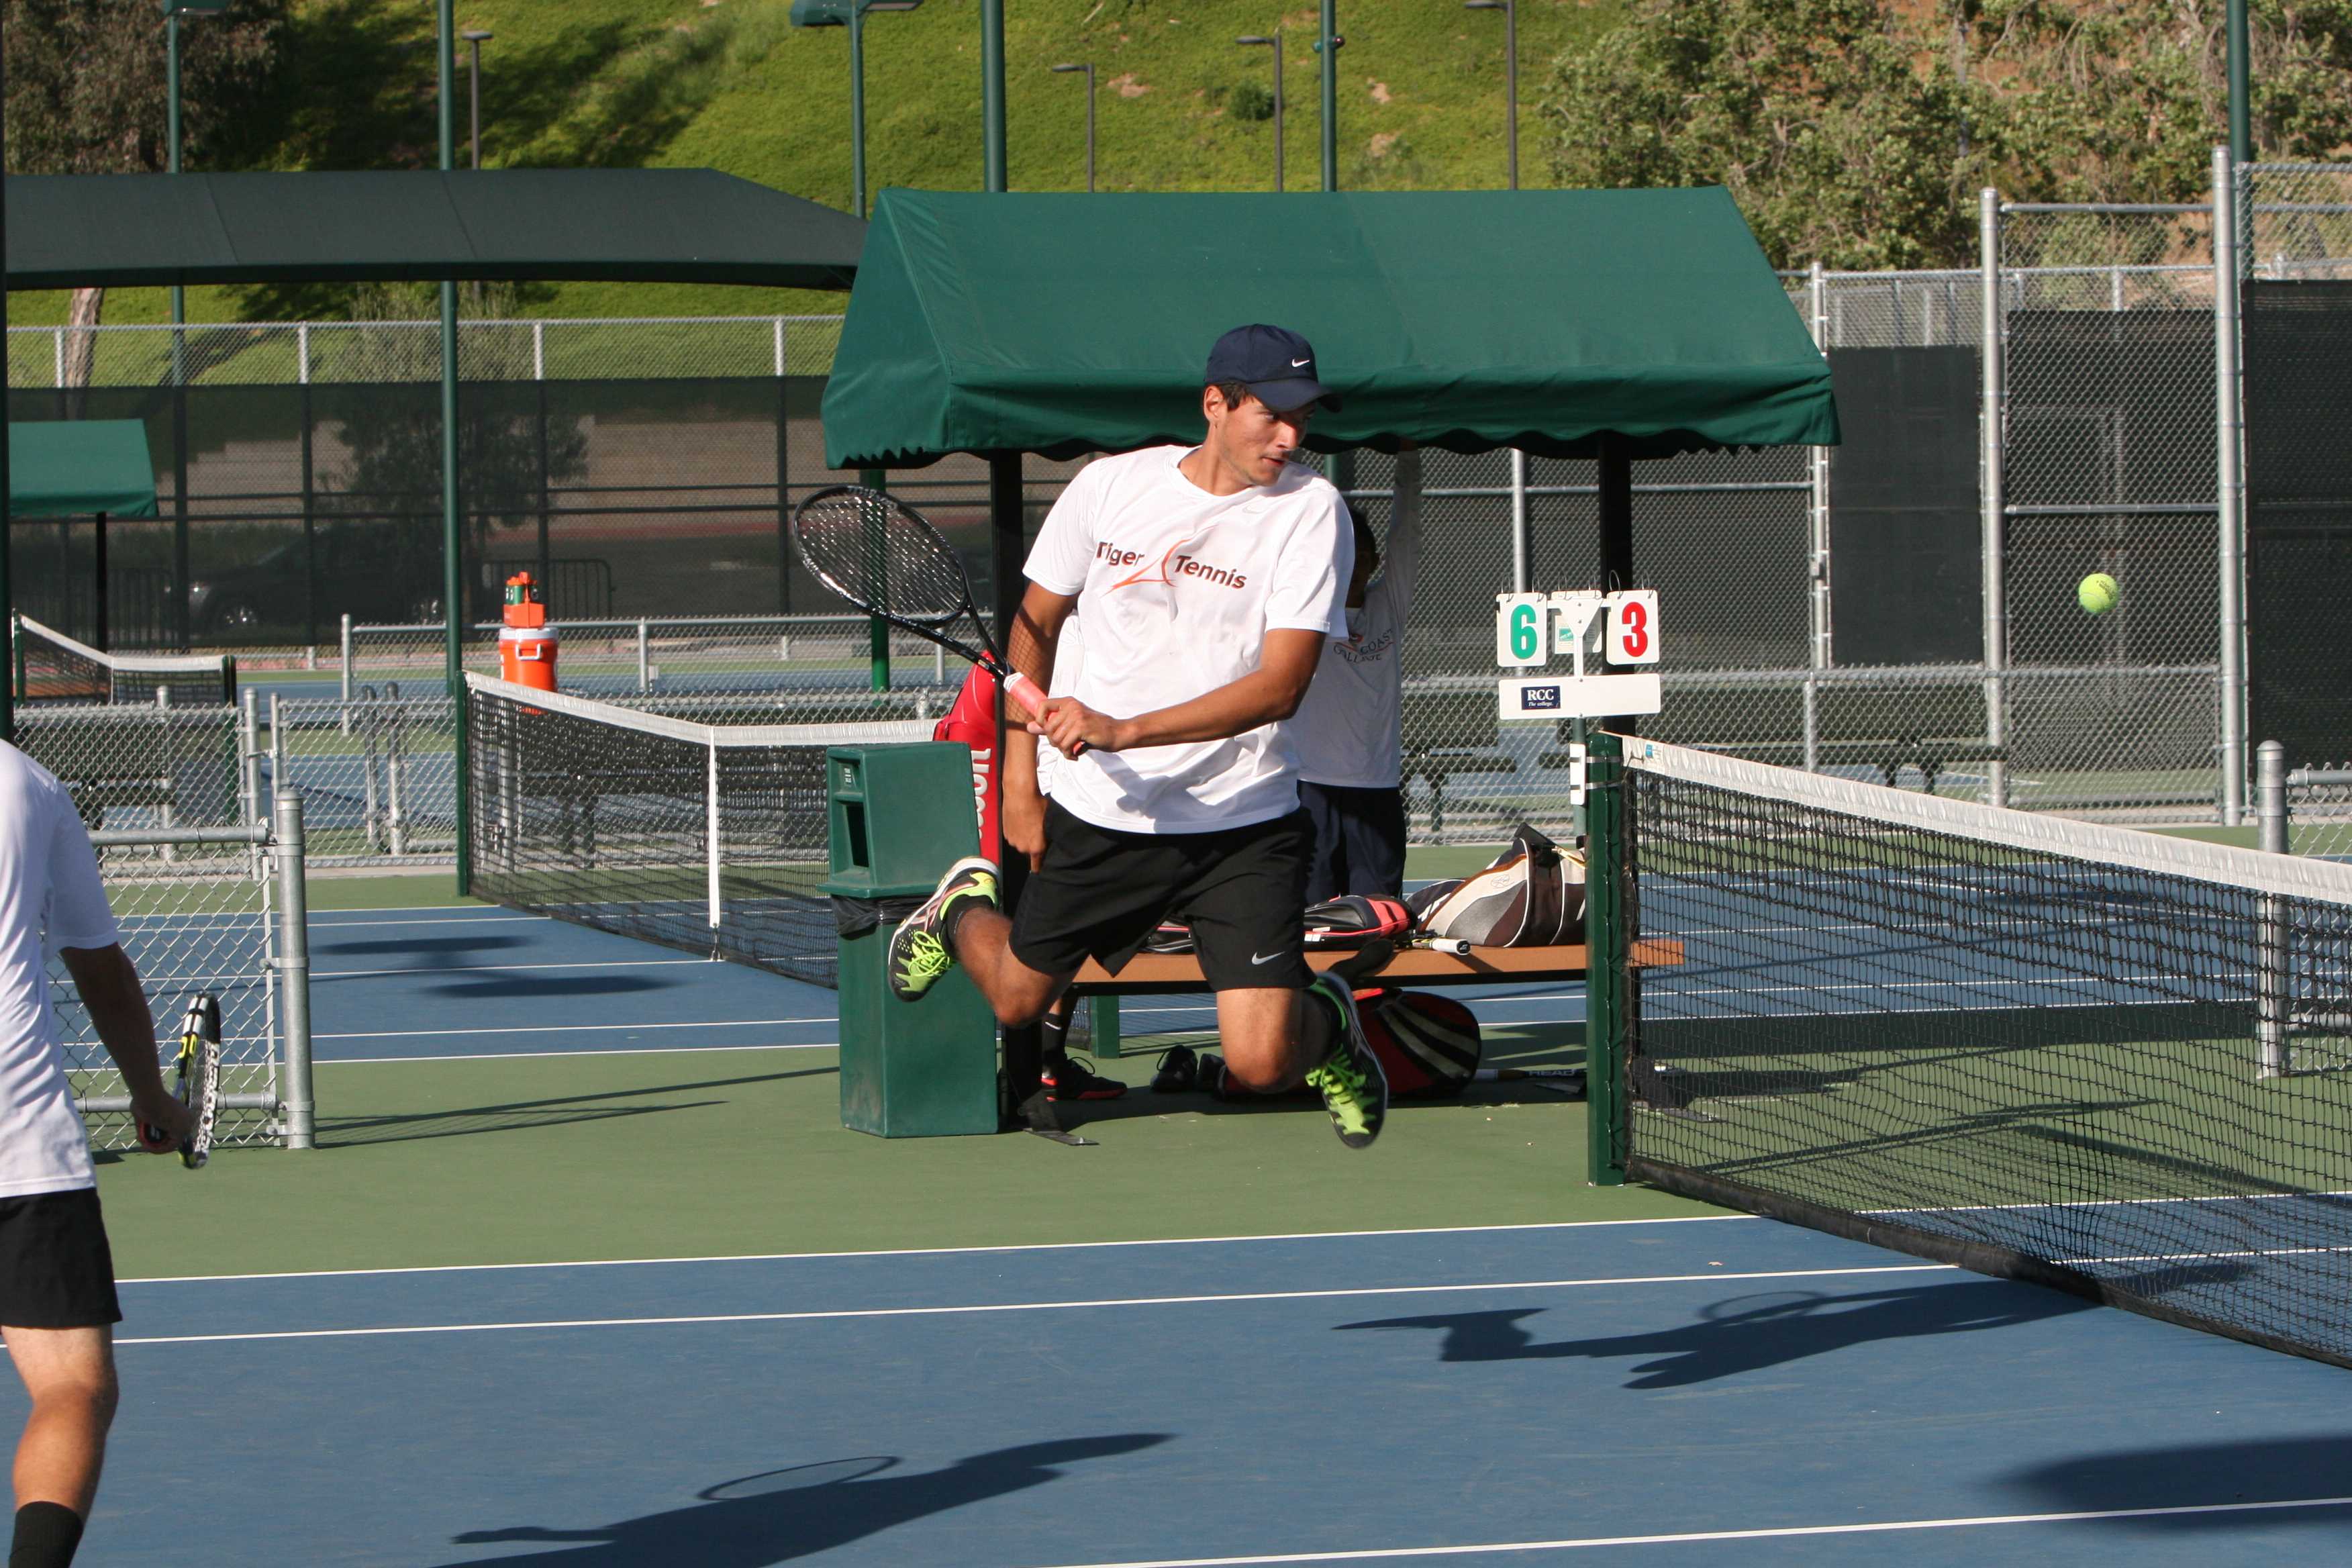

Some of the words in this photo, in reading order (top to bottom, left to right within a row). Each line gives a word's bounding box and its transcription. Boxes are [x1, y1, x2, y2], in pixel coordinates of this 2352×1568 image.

[1096, 541, 1144, 567] Tiger
[1175, 554, 1247, 589] Tennis
[1510, 604, 1537, 660] 6
[1622, 601, 1649, 657] 3
[1527, 689, 1554, 701] RCC
